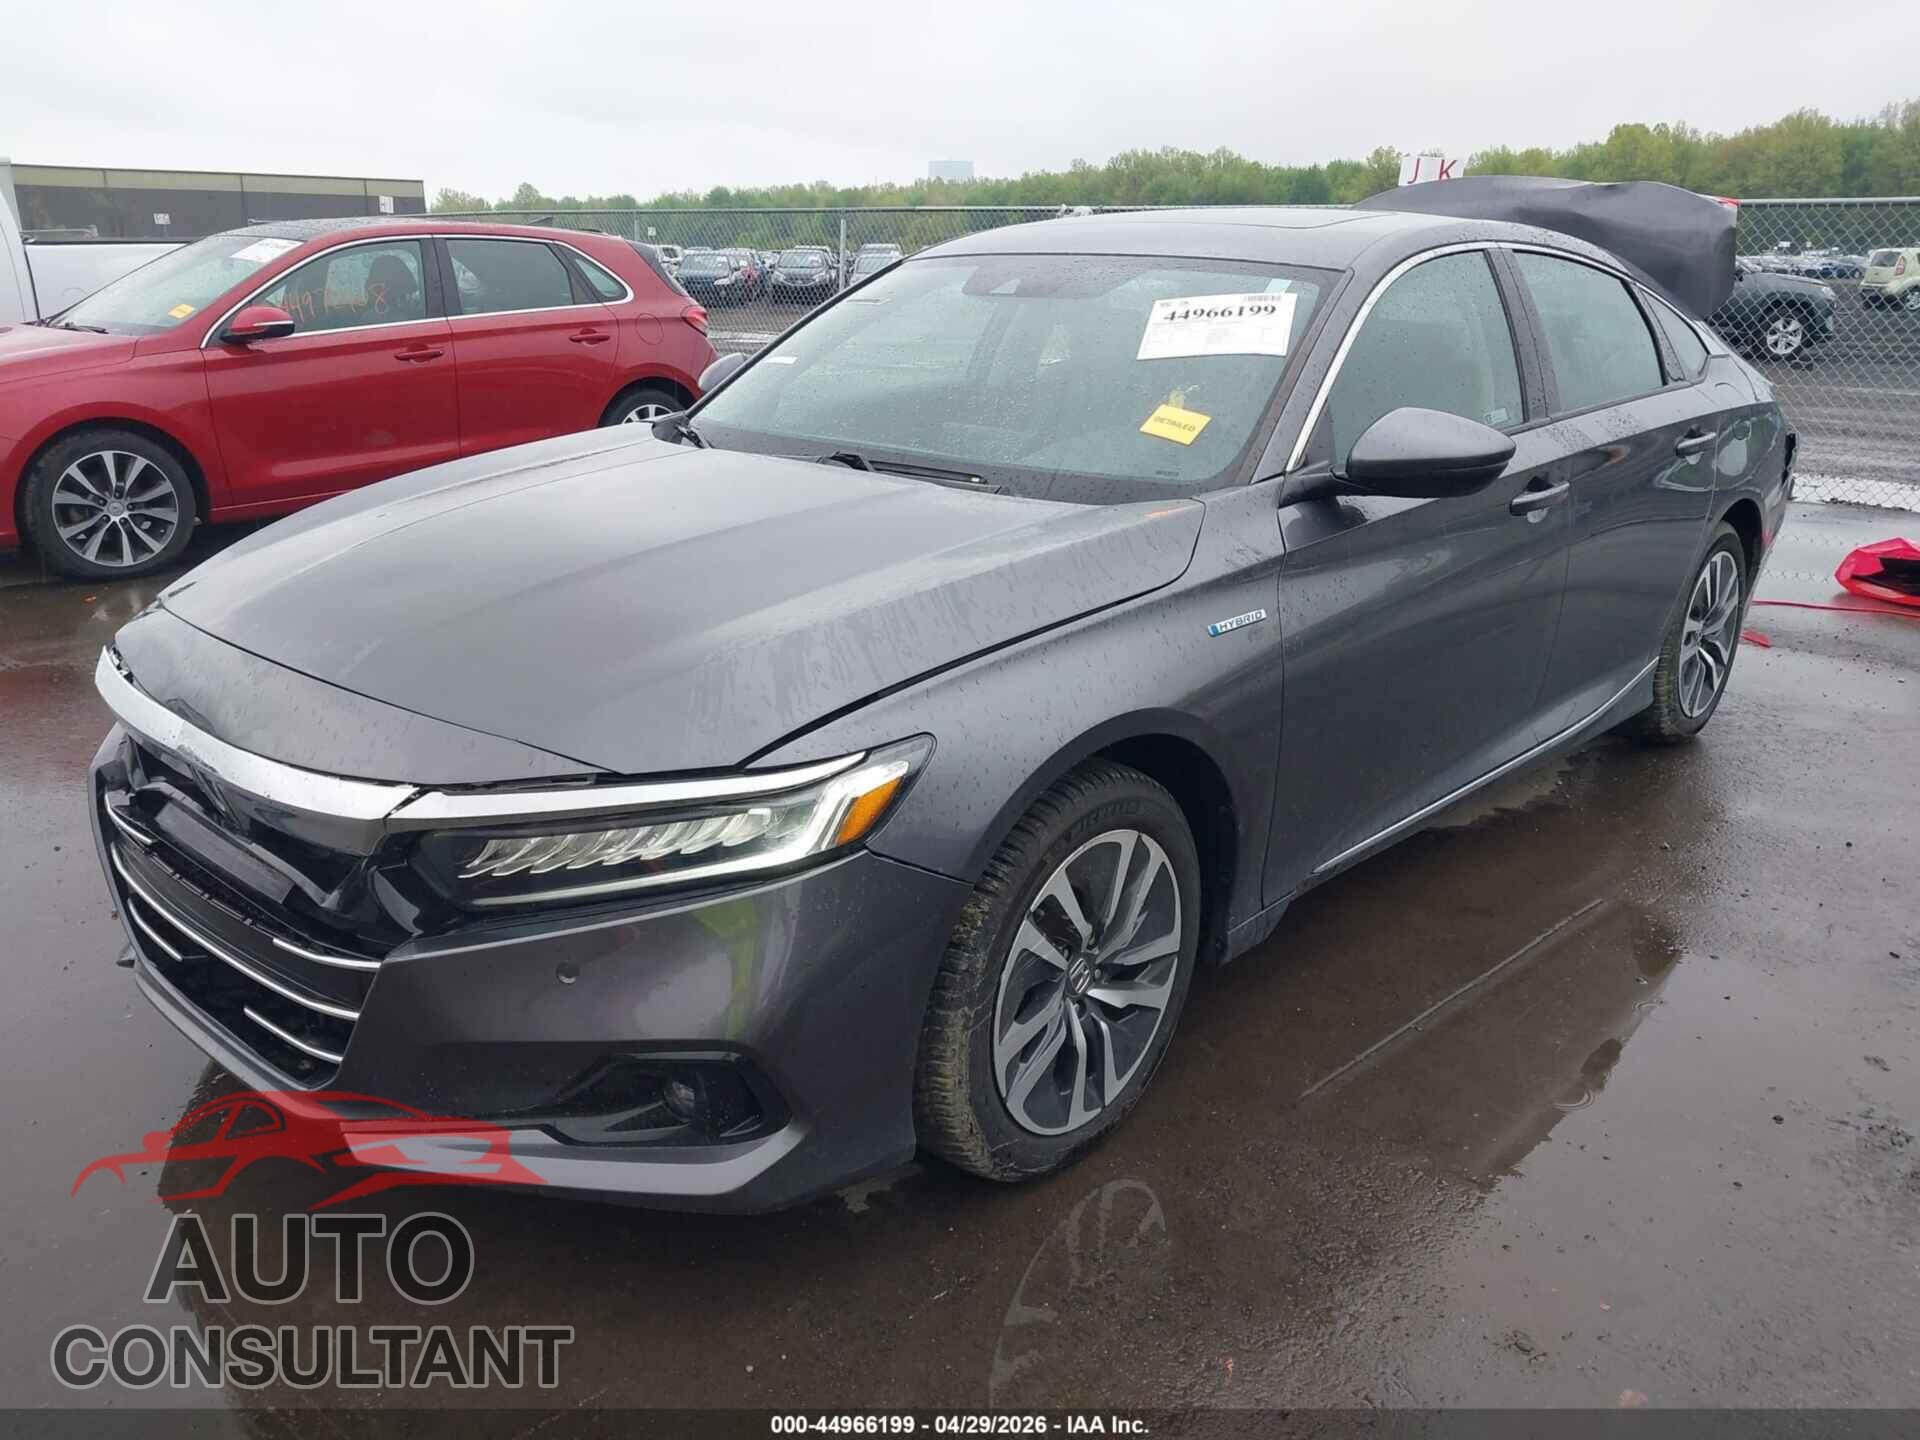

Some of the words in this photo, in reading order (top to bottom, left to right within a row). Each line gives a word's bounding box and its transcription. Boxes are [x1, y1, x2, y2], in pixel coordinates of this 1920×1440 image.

[1407, 158, 1420, 184] J
[1439, 159, 1458, 181] K
[1163, 305, 1277, 321] 44966199
[1219, 610, 1263, 633] HYBRID
